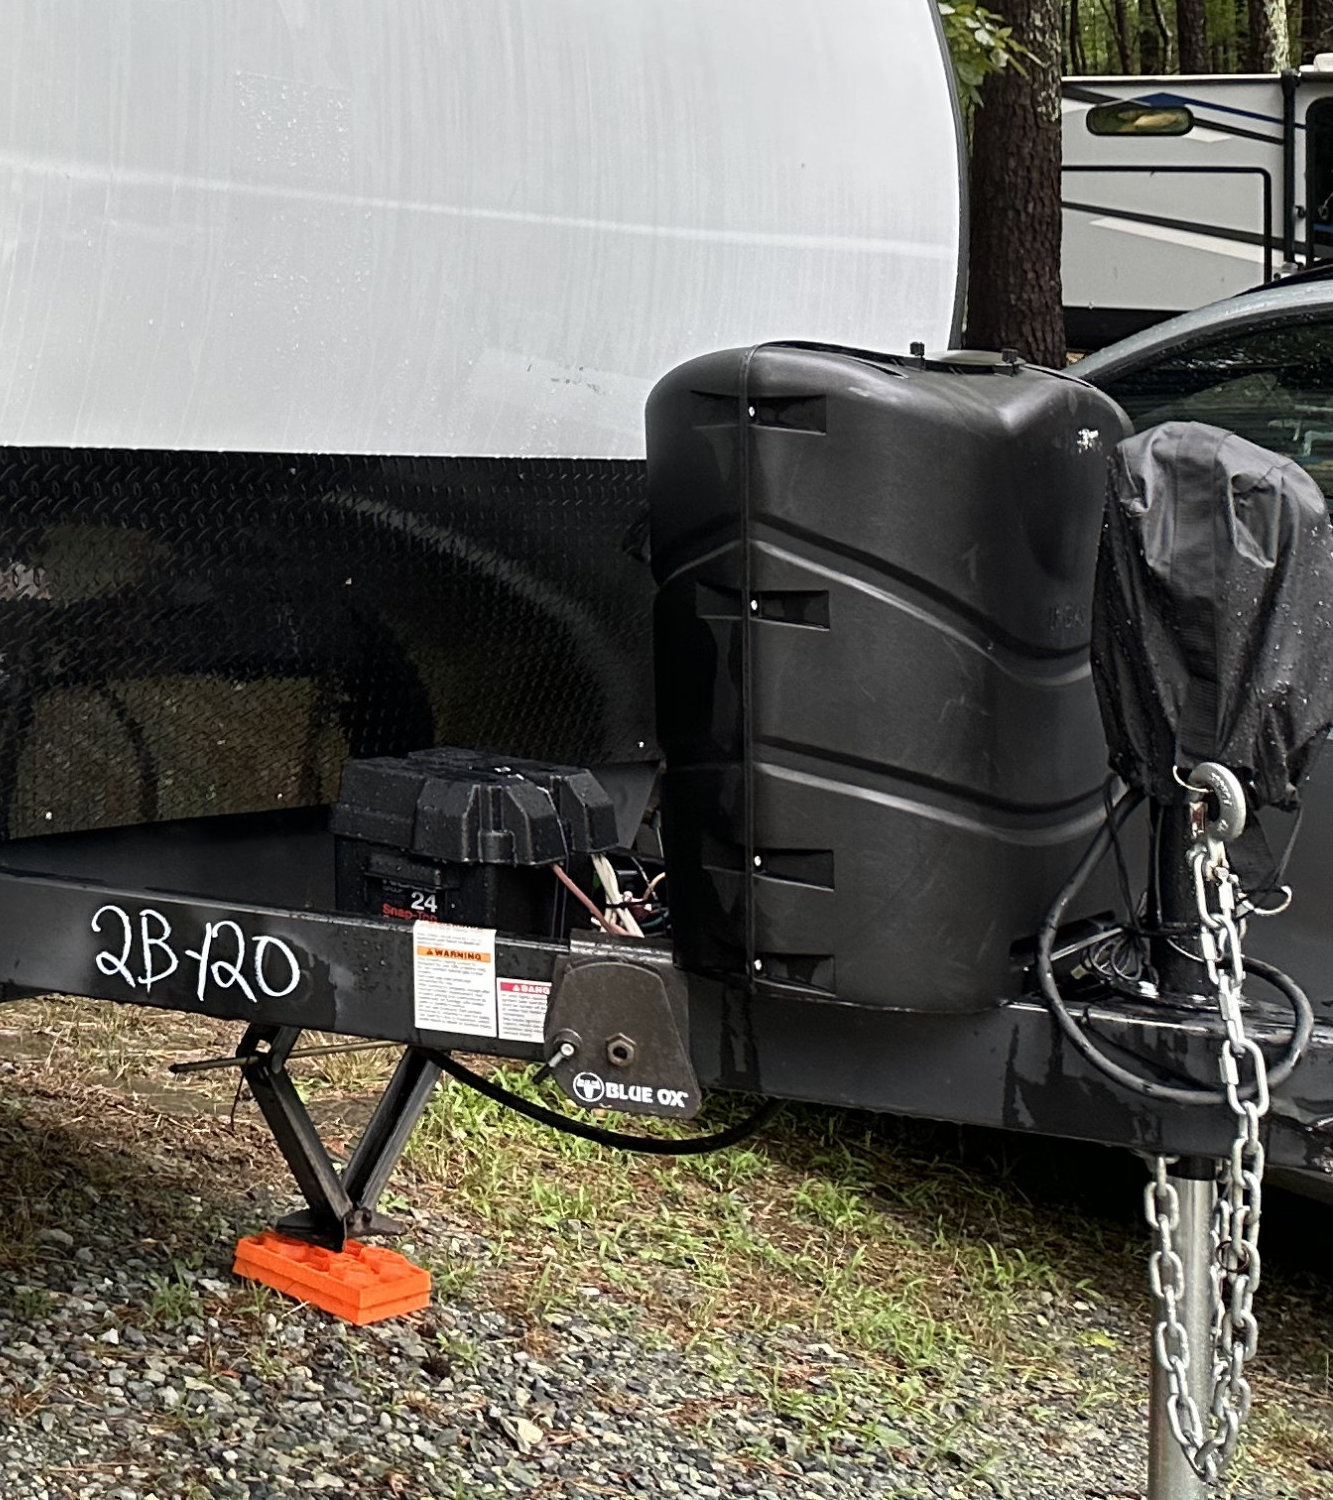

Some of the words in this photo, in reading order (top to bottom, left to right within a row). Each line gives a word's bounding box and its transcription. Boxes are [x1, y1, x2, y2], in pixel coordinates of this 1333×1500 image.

[410, 891, 438, 913] 24
[435, 948, 482, 961] WARNING
[521, 984, 551, 995] DANG
[605, 1082, 653, 1103] BLUE
[657, 1088, 685, 1108] OX
